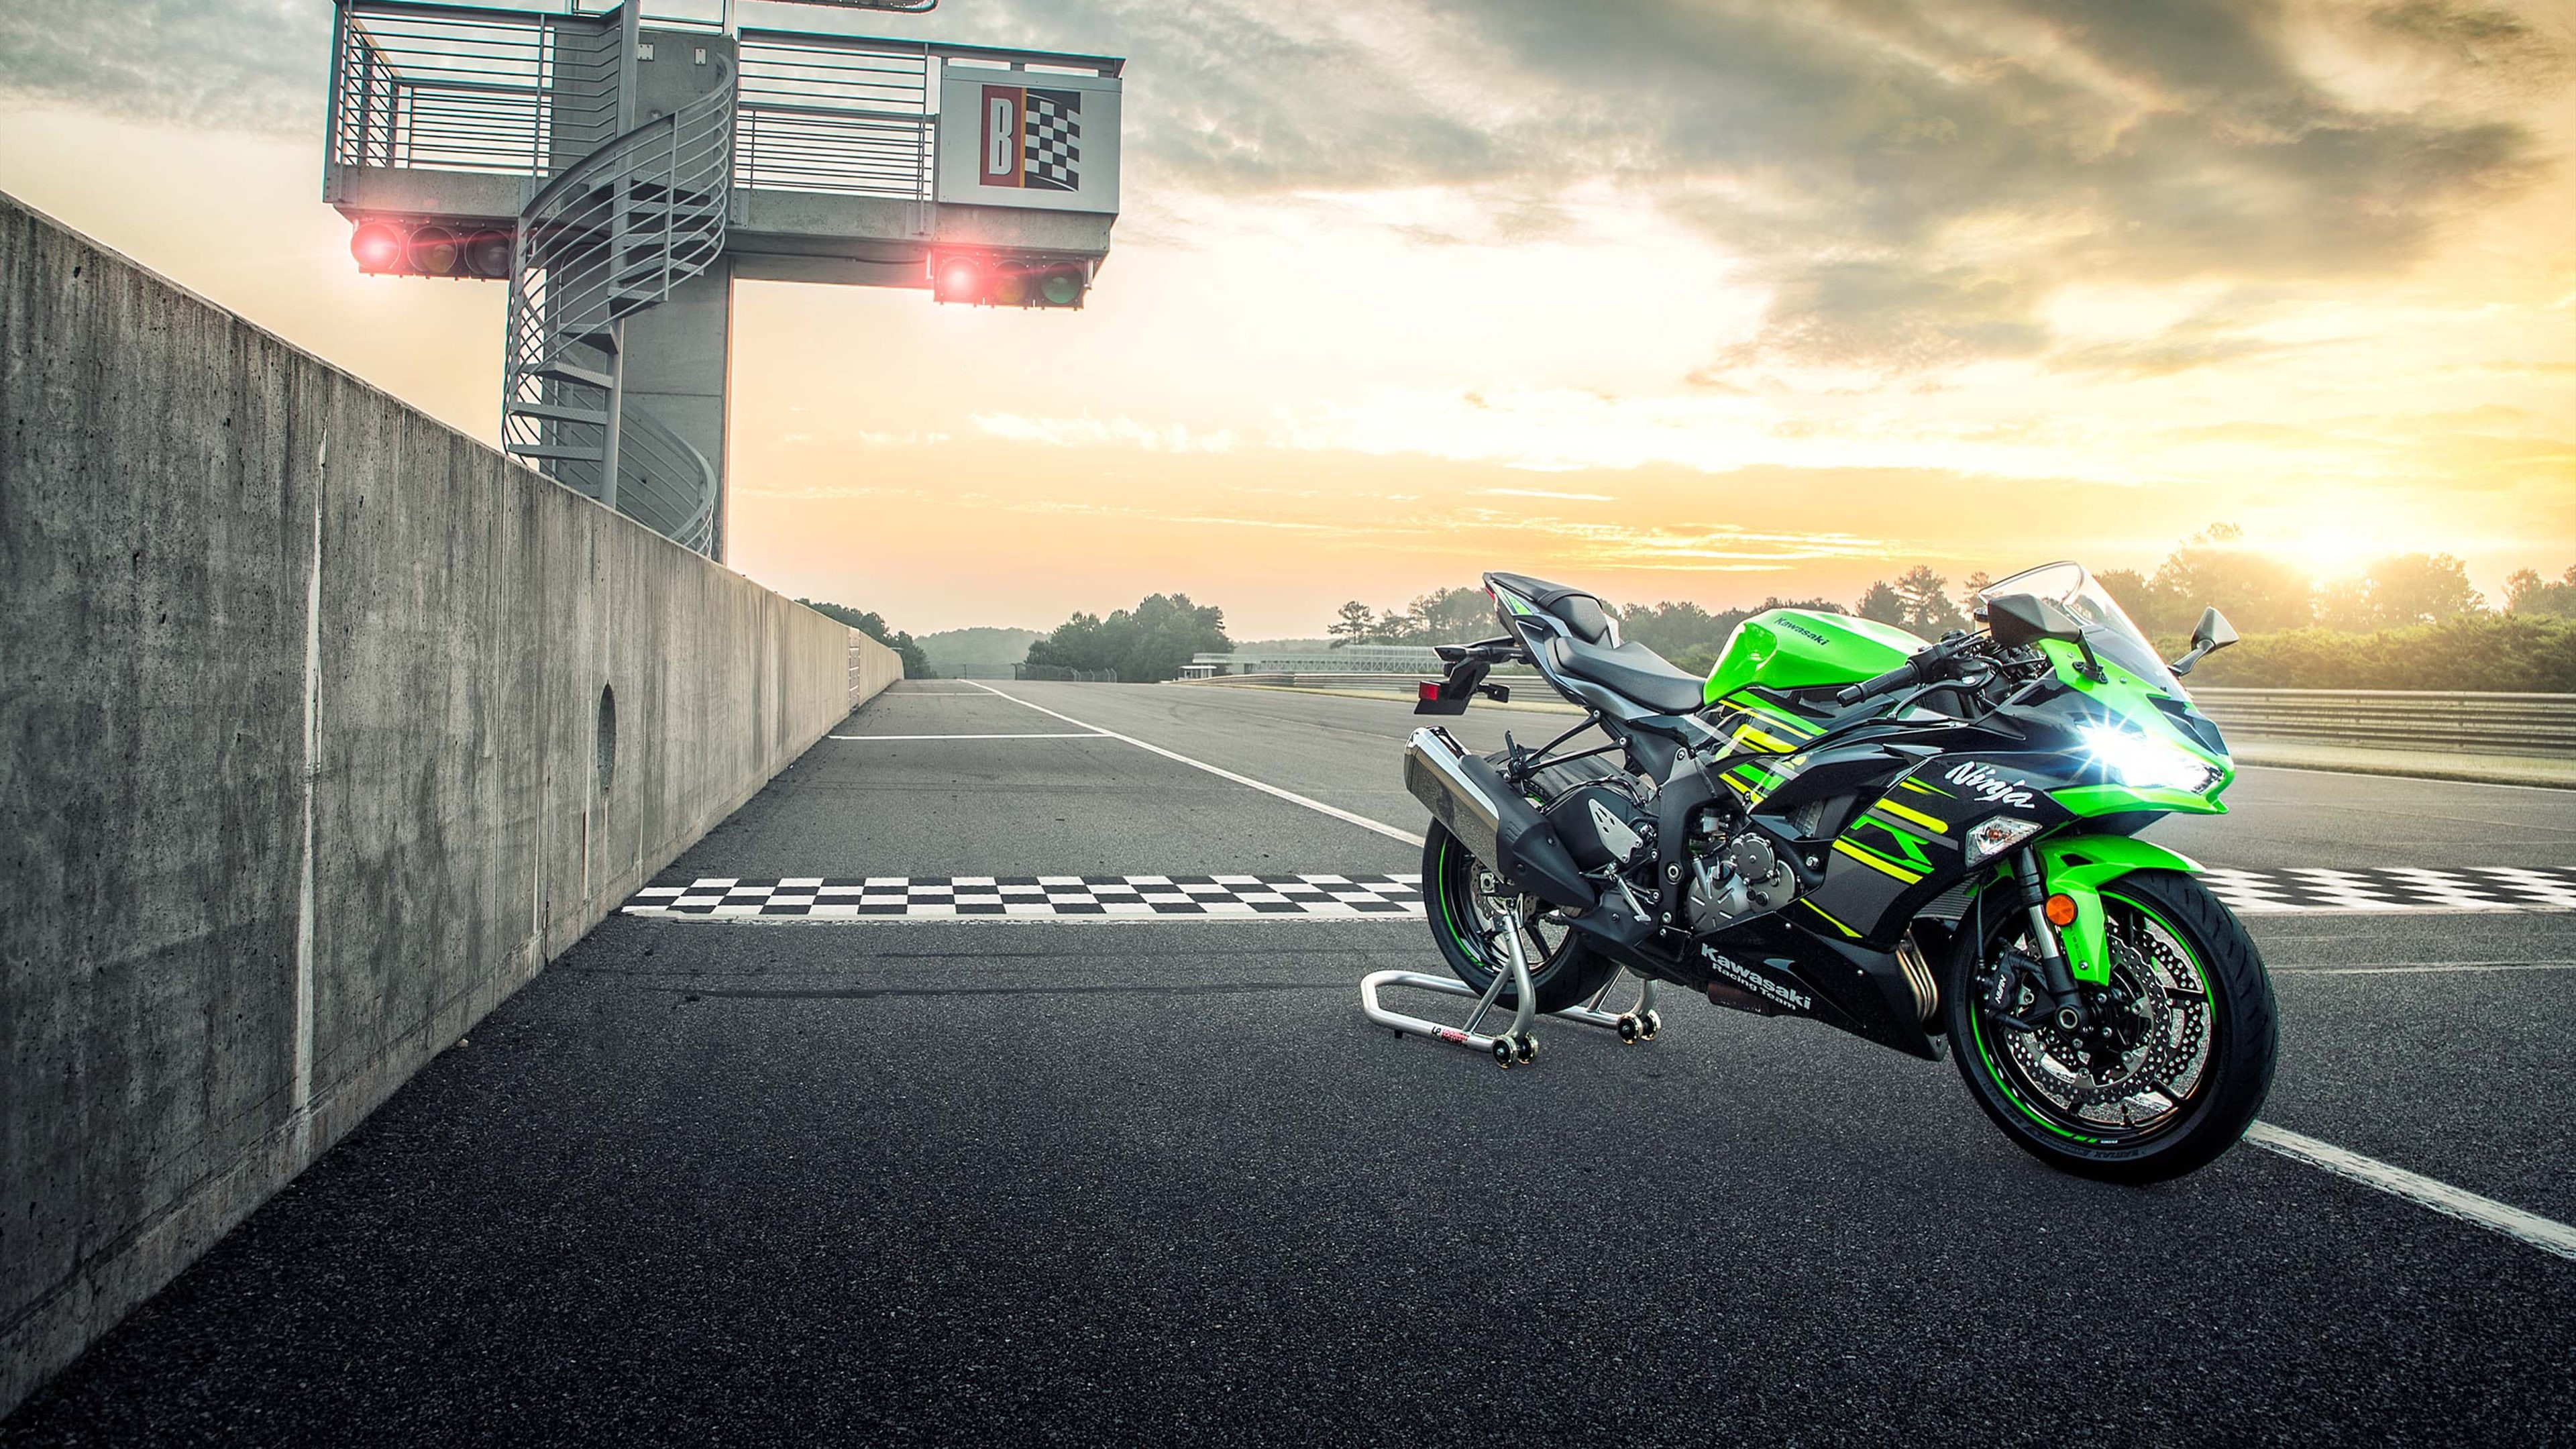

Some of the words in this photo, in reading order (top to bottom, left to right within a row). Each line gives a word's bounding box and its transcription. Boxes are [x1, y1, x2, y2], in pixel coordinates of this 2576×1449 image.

[988, 97, 1014, 175] B
[1774, 617, 1830, 645] Kawasaki
[1944, 761, 2035, 808] Ninja
[1701, 943, 1811, 1010] Kawasaki
[1712, 963, 1758, 991] Racing
[1760, 987, 1796, 1010] Team
